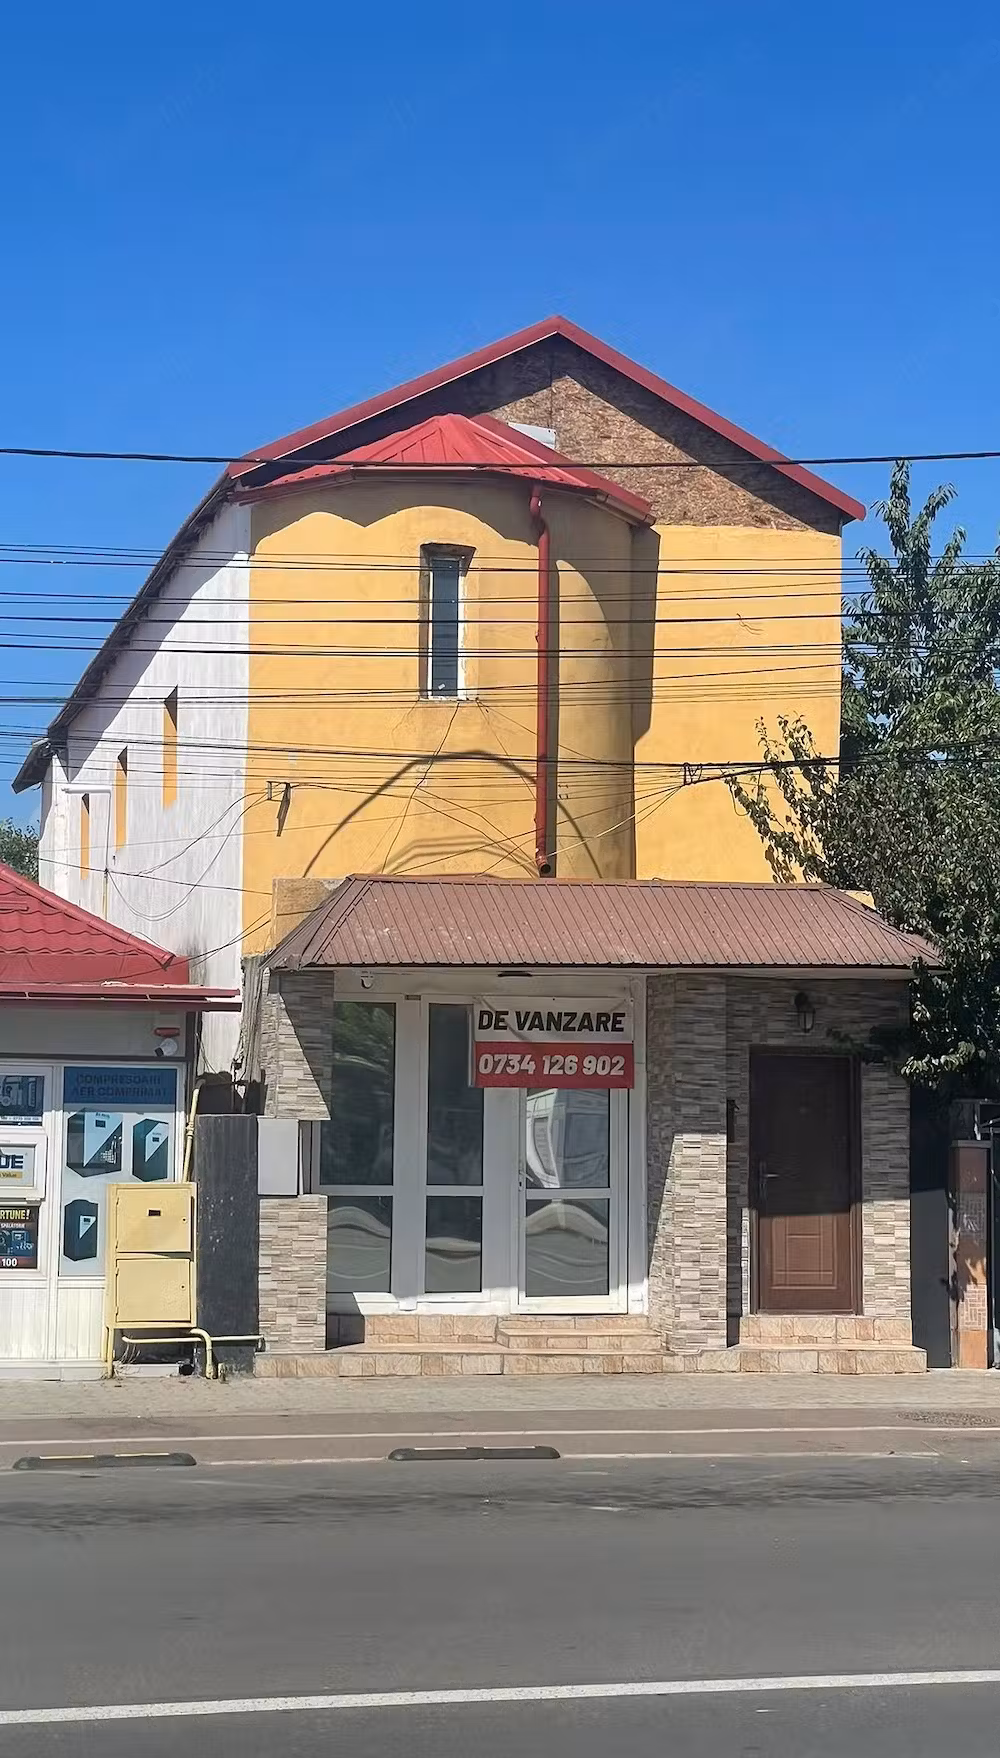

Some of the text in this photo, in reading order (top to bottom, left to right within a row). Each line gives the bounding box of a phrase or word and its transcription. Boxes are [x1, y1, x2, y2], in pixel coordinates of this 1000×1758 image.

[478, 1010, 626, 1033] DE VANZARE
[478, 1053, 625, 1076] 0734 126 902
[73, 1086, 95, 1097] AER
[2, 1257, 18, 1267] 100
